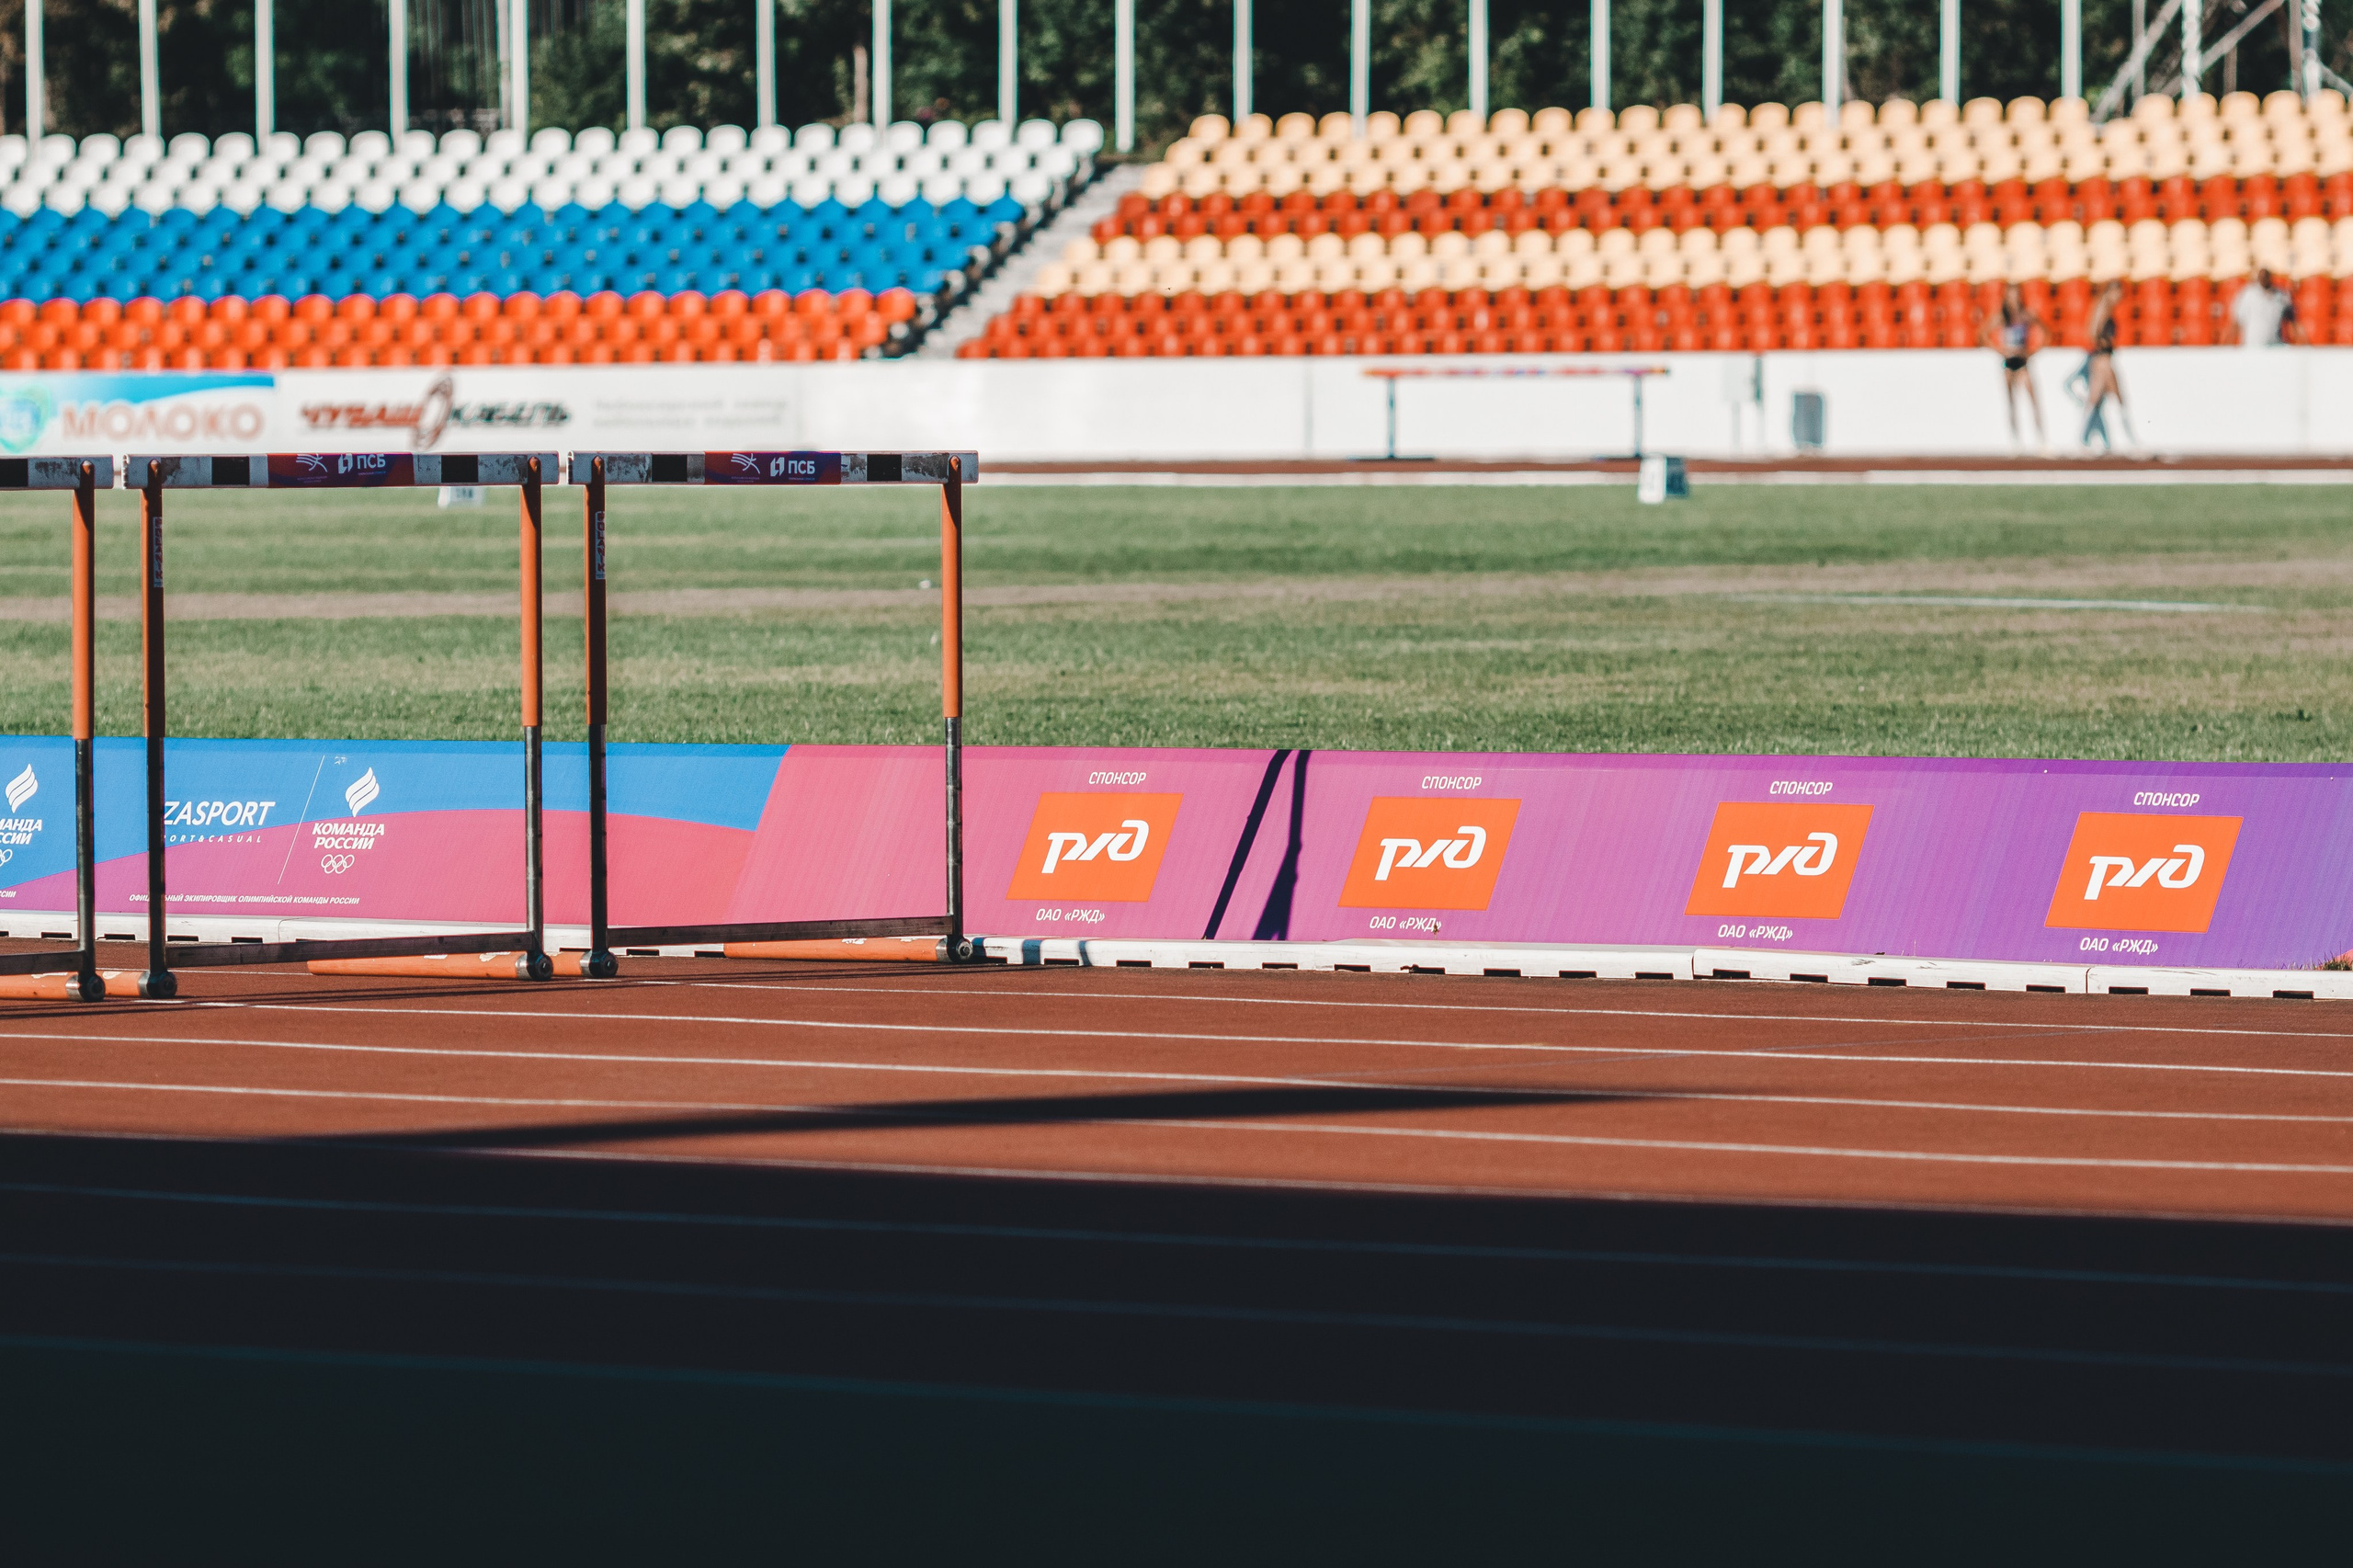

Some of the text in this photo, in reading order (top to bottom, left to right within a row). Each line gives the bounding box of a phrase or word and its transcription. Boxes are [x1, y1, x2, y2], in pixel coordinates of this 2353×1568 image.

[63, 402, 266, 442] МОЛОКО
[357, 453, 386, 469] ПСБ
[788, 460, 815, 474] ПСБ
[1088, 771, 1147, 785] СПОНСОР
[1421, 776, 1482, 790] СПОНСОР
[1769, 780, 1833, 795] СПОНСОР
[2133, 791, 2200, 807] СПОНСОР
[165, 801, 276, 826] ZASPORT
[312, 823, 385, 837] КОМАНДА
[313, 836, 375, 850] РОССИИ
[184, 894, 237, 903] ЭКИПИРОВЩИК
[238, 895, 292, 903] ОЛИМПИЙСКОЙ
[1035, 908, 1106, 924] ОАО «РЖД»
[1369, 916, 1396, 929] ОАО
[1717, 925, 1793, 941] ОАО «РЖД»
[2079, 937, 2159, 955] ОАО «РЖД»
